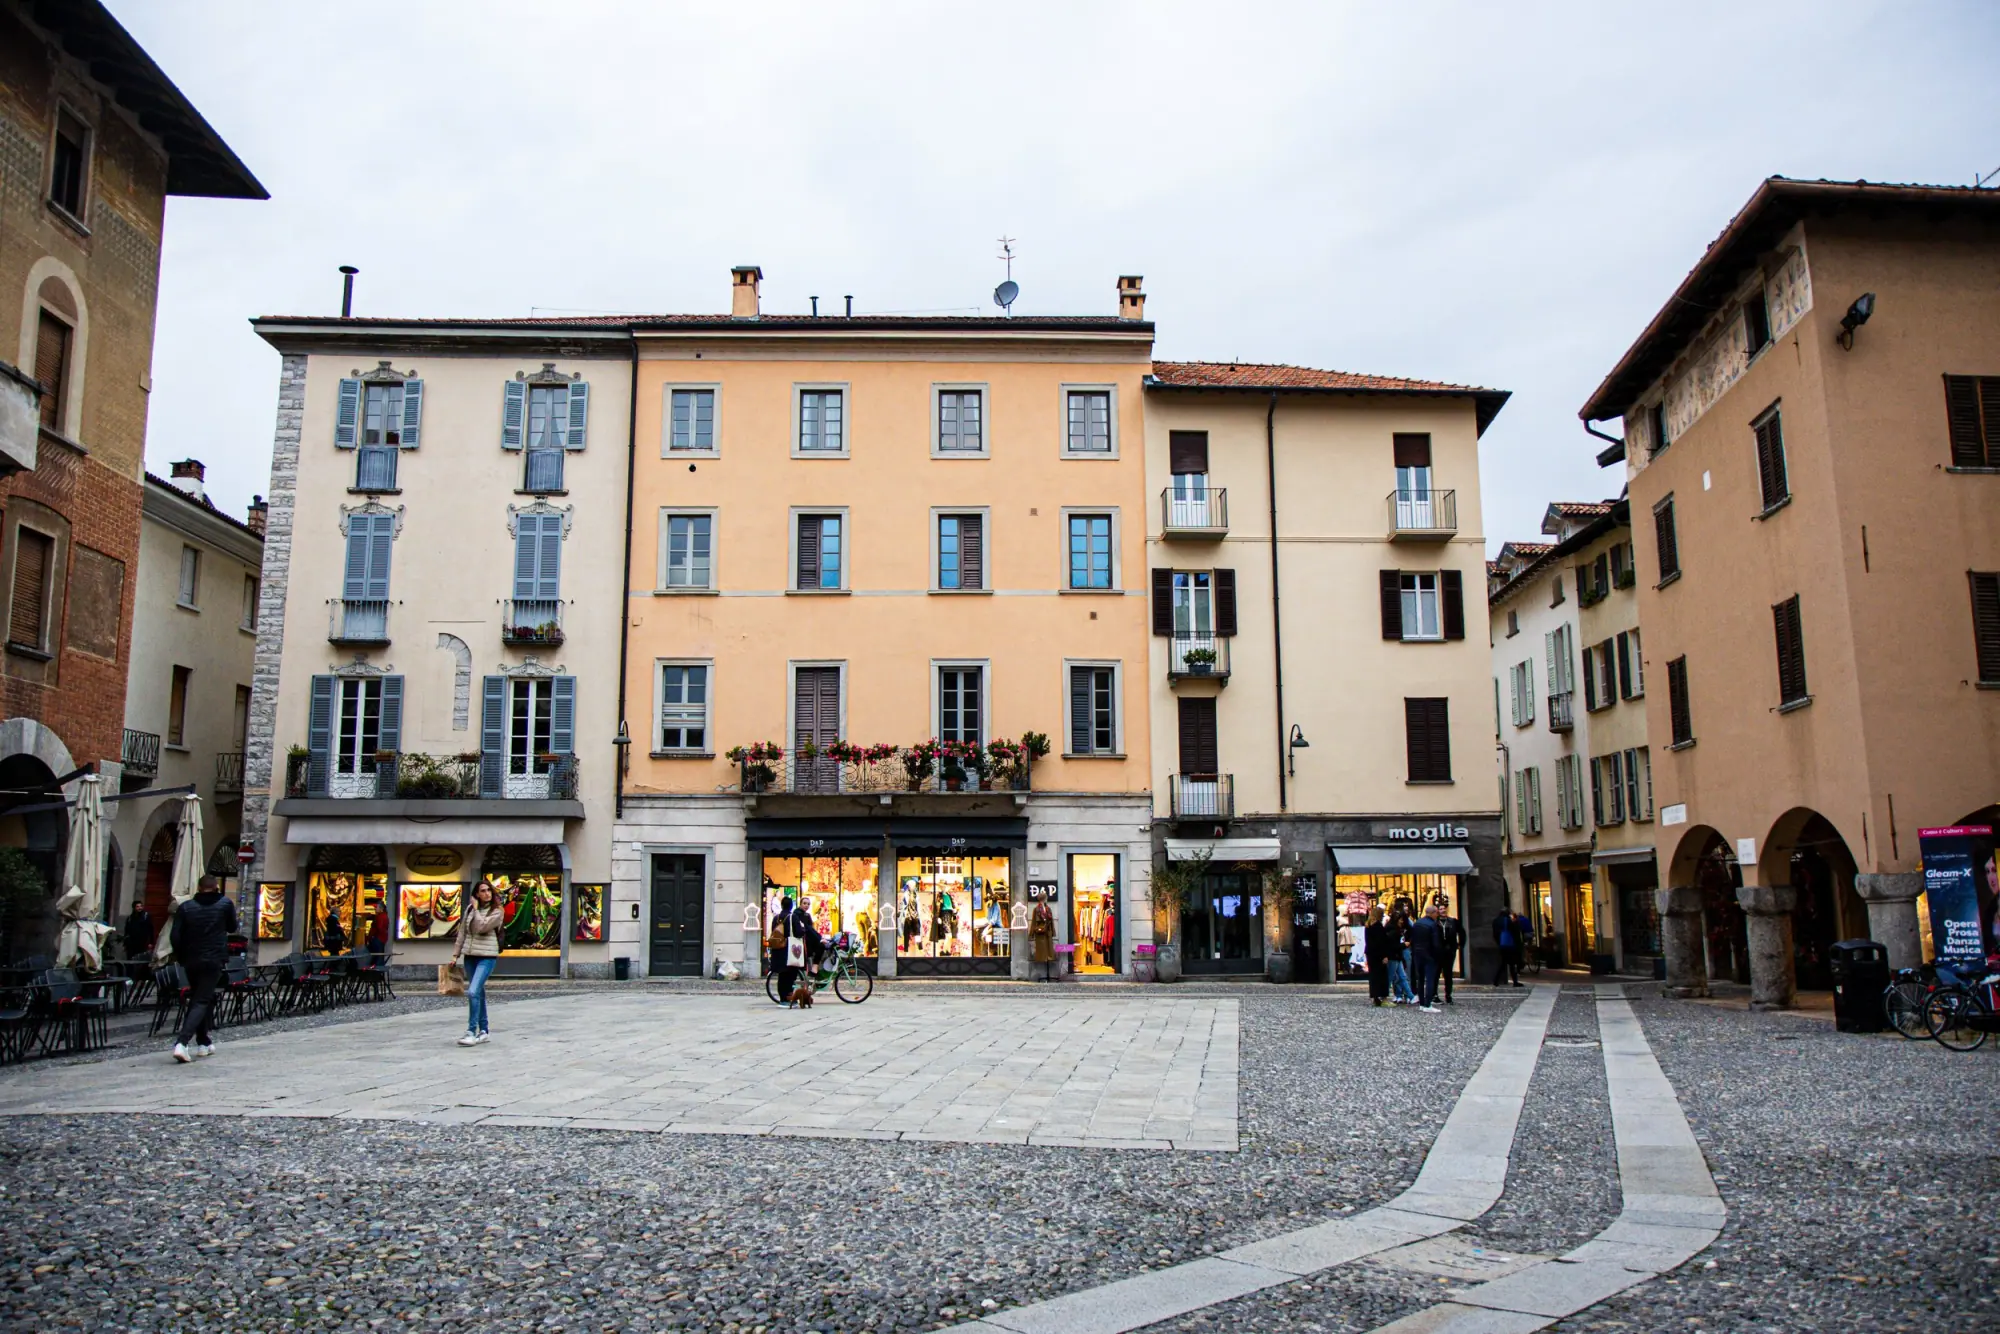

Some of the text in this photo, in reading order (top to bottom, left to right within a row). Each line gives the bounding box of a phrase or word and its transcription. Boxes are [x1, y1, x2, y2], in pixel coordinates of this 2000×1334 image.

[1388, 823, 1469, 842] moglia
[1925, 868, 1972, 878] Gleam-X
[1944, 919, 1978, 930] Opera
[1948, 928, 1979, 937] Prosa
[1946, 937, 1981, 945] Danza
[1943, 945, 1981, 954] Musica
